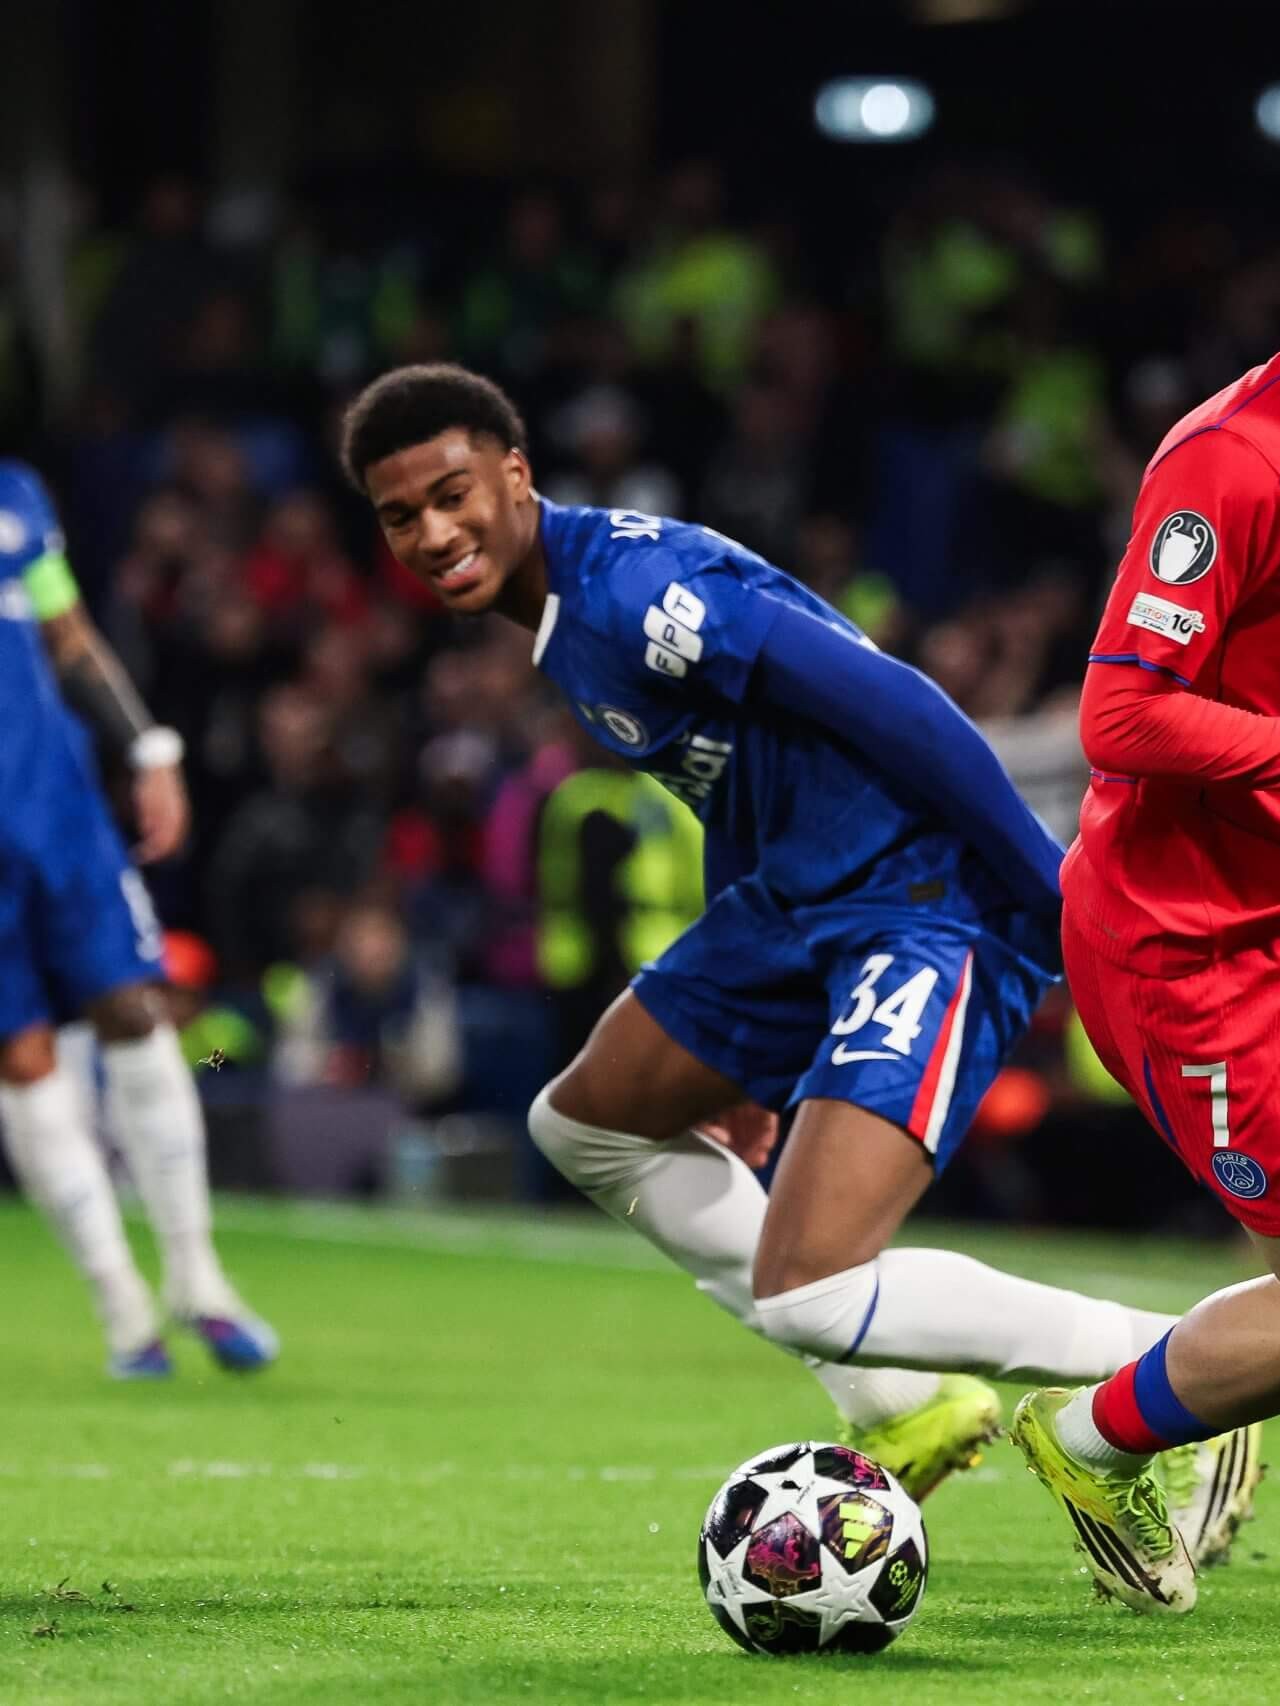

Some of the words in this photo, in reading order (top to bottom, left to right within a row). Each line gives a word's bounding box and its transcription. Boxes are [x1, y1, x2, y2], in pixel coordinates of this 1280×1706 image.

[653, 592, 694, 676] FPT
[831, 953, 939, 1056] 34
[1181, 1060, 1230, 1147] 7
[1215, 1153, 1248, 1165] PARIS
